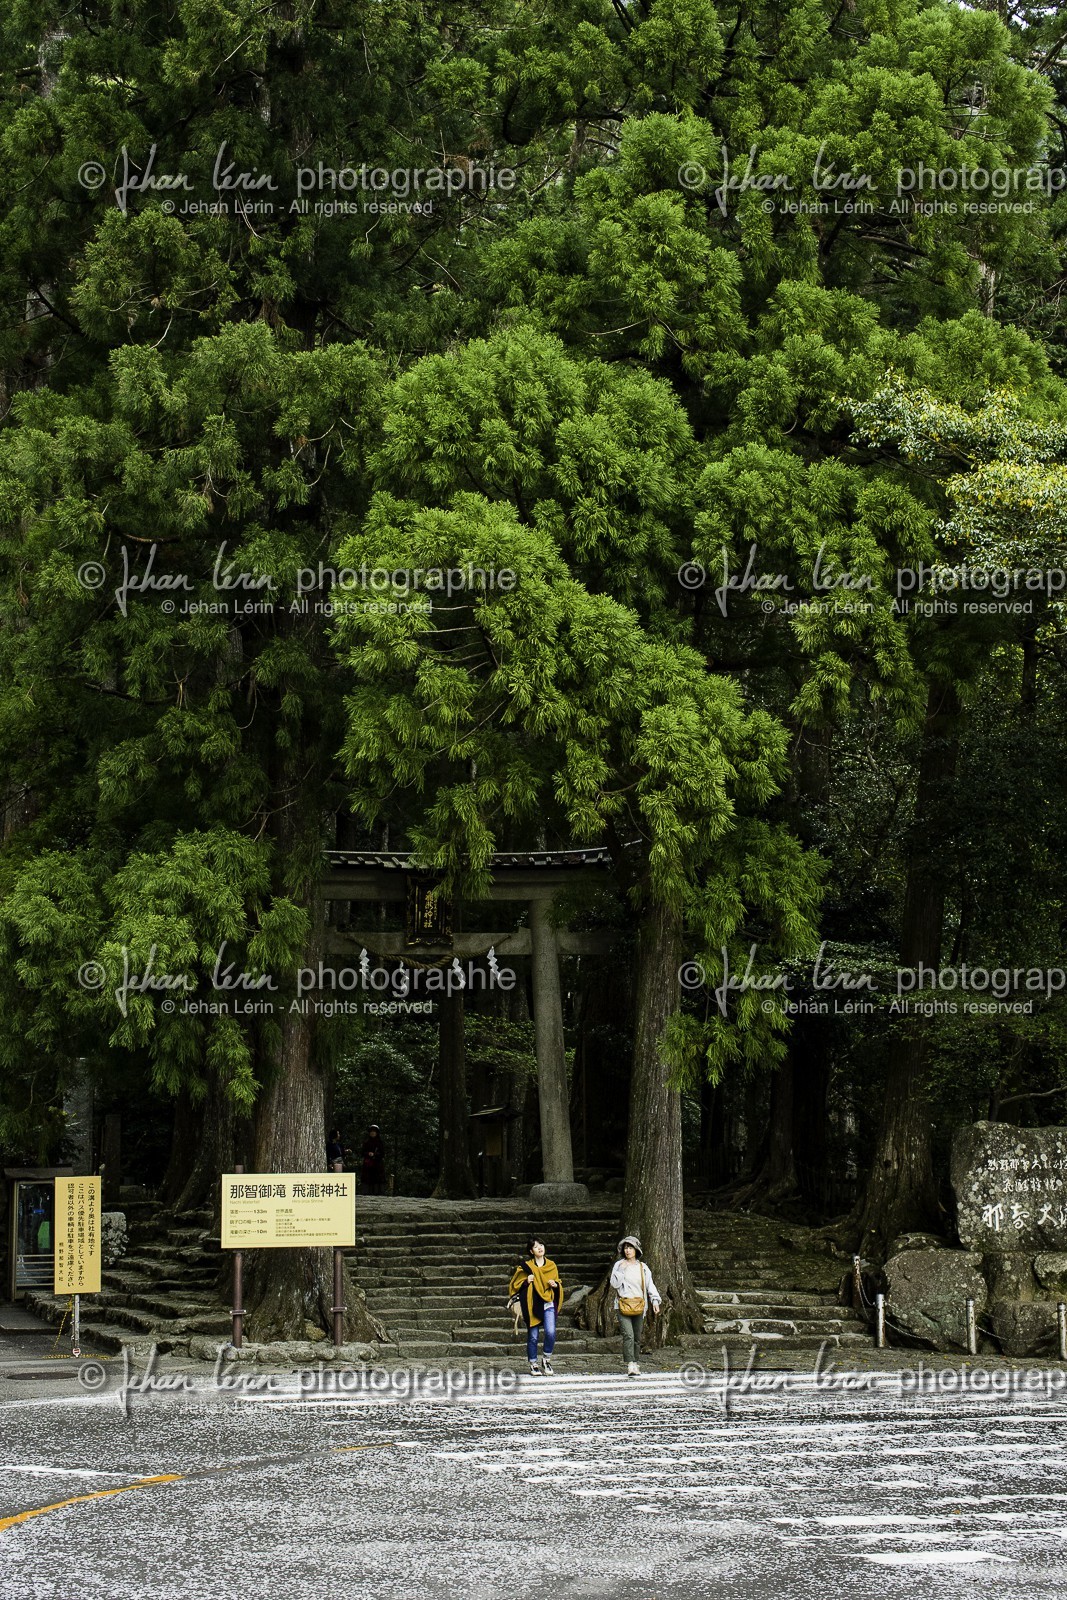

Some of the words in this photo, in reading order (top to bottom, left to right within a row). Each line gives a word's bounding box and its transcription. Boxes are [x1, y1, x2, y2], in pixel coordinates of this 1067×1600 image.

[230, 1184, 287, 1199] 那智御滝
[292, 1182, 348, 1198] 飛瀧神社
